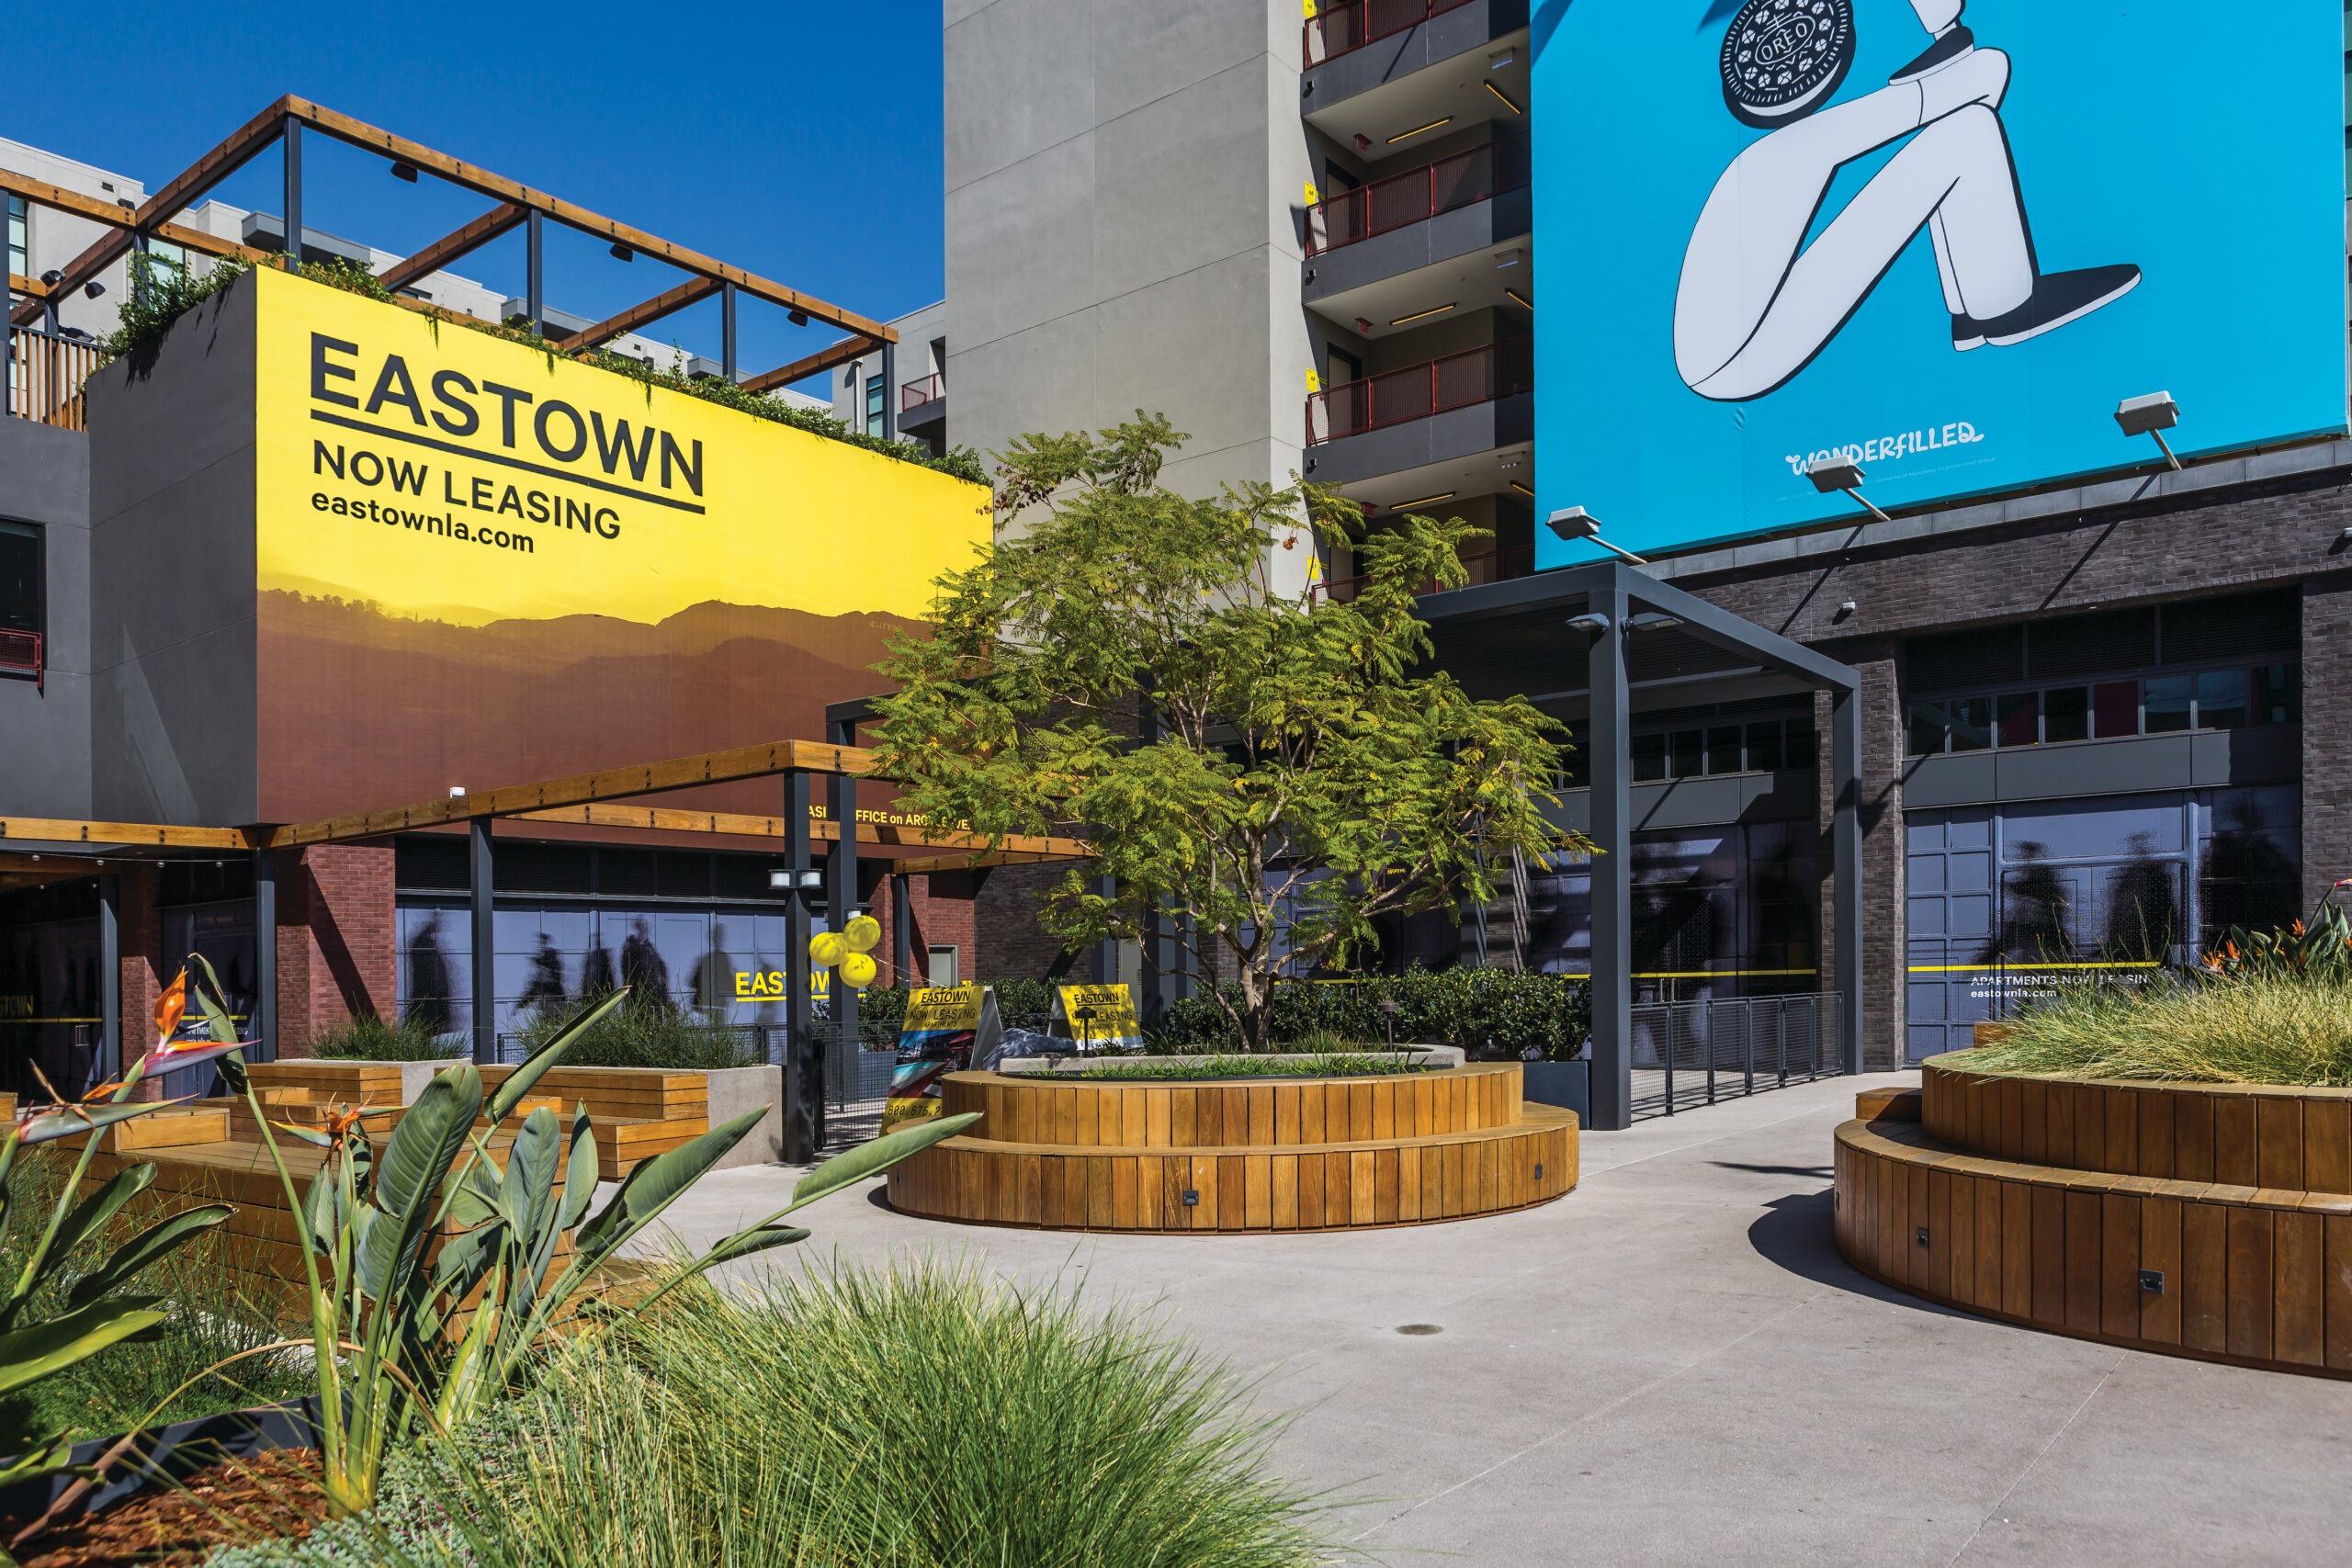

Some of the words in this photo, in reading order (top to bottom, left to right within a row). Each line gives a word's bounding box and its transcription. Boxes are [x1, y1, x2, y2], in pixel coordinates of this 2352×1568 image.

[1761, 22, 1808, 61] OREO
[311, 332, 704, 496] EASTOWN
[313, 439, 428, 496] NOW
[444, 470, 621, 540] LEASING
[311, 491, 534, 554] eastownla.com
[855, 809, 888, 824] FFICE
[890, 815, 903, 826] on
[1971, 976, 2057, 987] APARTMENTS
[922, 990, 971, 1004] EASTOWN
[1074, 993, 1119, 1004] EASTOWN
[1971, 988, 2057, 998] eastownla.com
[910, 1010, 928, 1021] NOW
[933, 1008, 976, 1021] LEASING
[1096, 1011, 1133, 1022] LEASING
[888, 1105, 942, 1116] 800.675.2
